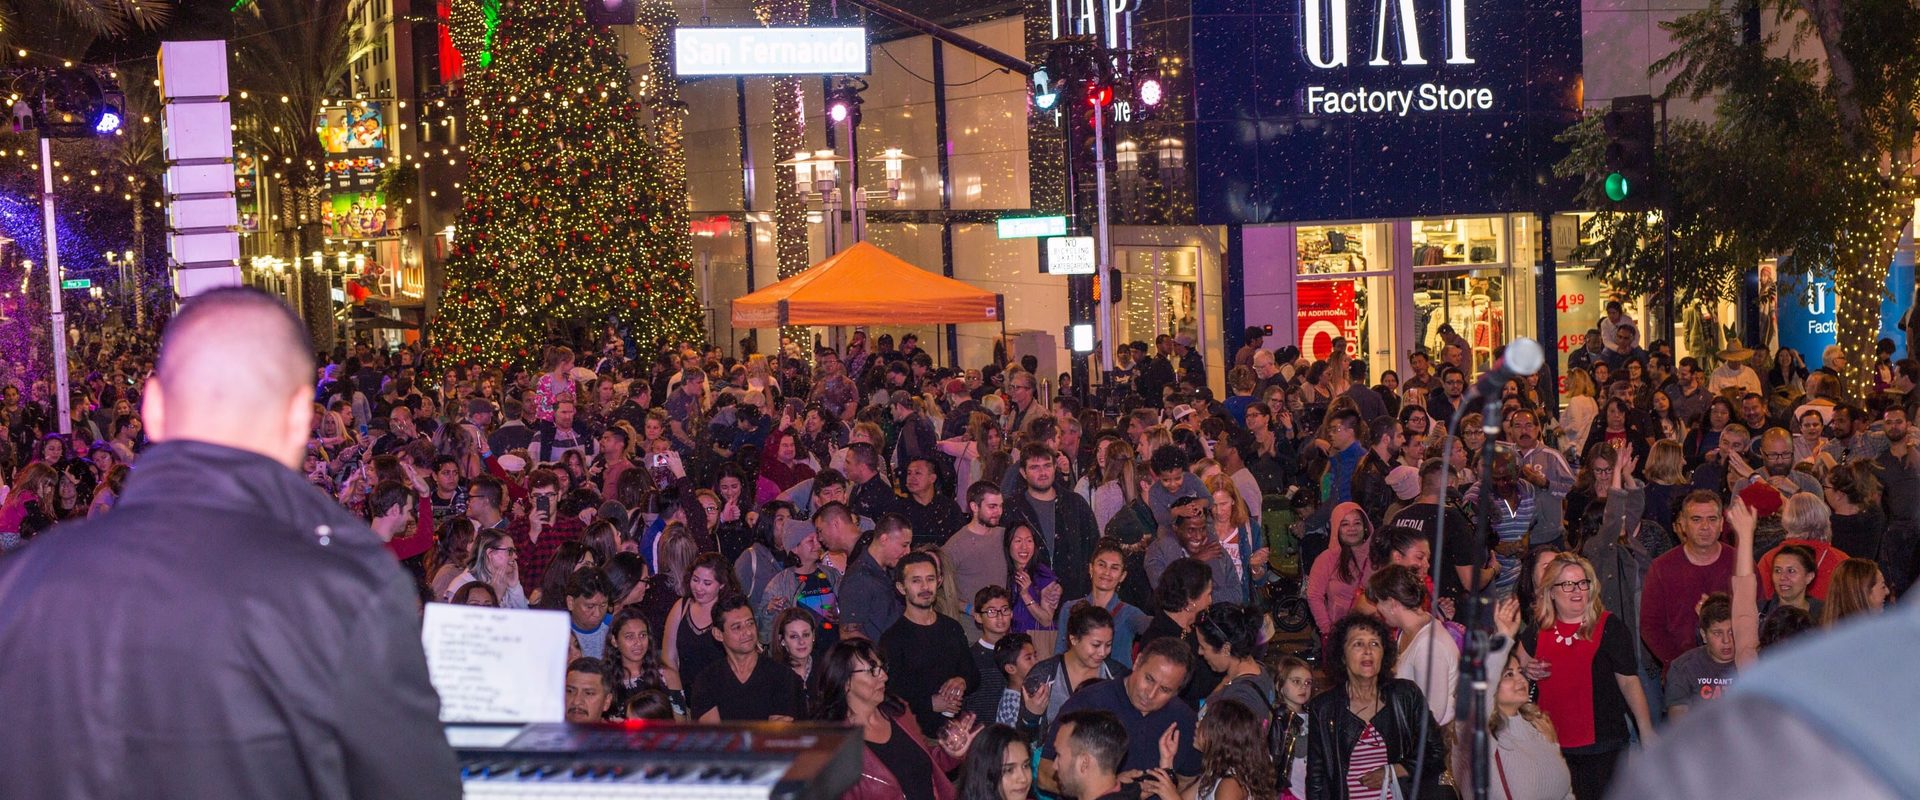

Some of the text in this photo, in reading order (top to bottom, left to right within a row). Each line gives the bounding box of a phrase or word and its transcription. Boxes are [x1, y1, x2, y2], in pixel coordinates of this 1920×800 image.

[683, 34, 858, 64] San Fernando
[1308, 83, 1493, 116] Factory Store
[1065, 239, 1077, 248] NO
[1308, 309, 1348, 317] ADDITIONAL
[1345, 320, 1357, 355] OFF
[1396, 519, 1424, 531] MEDIA
